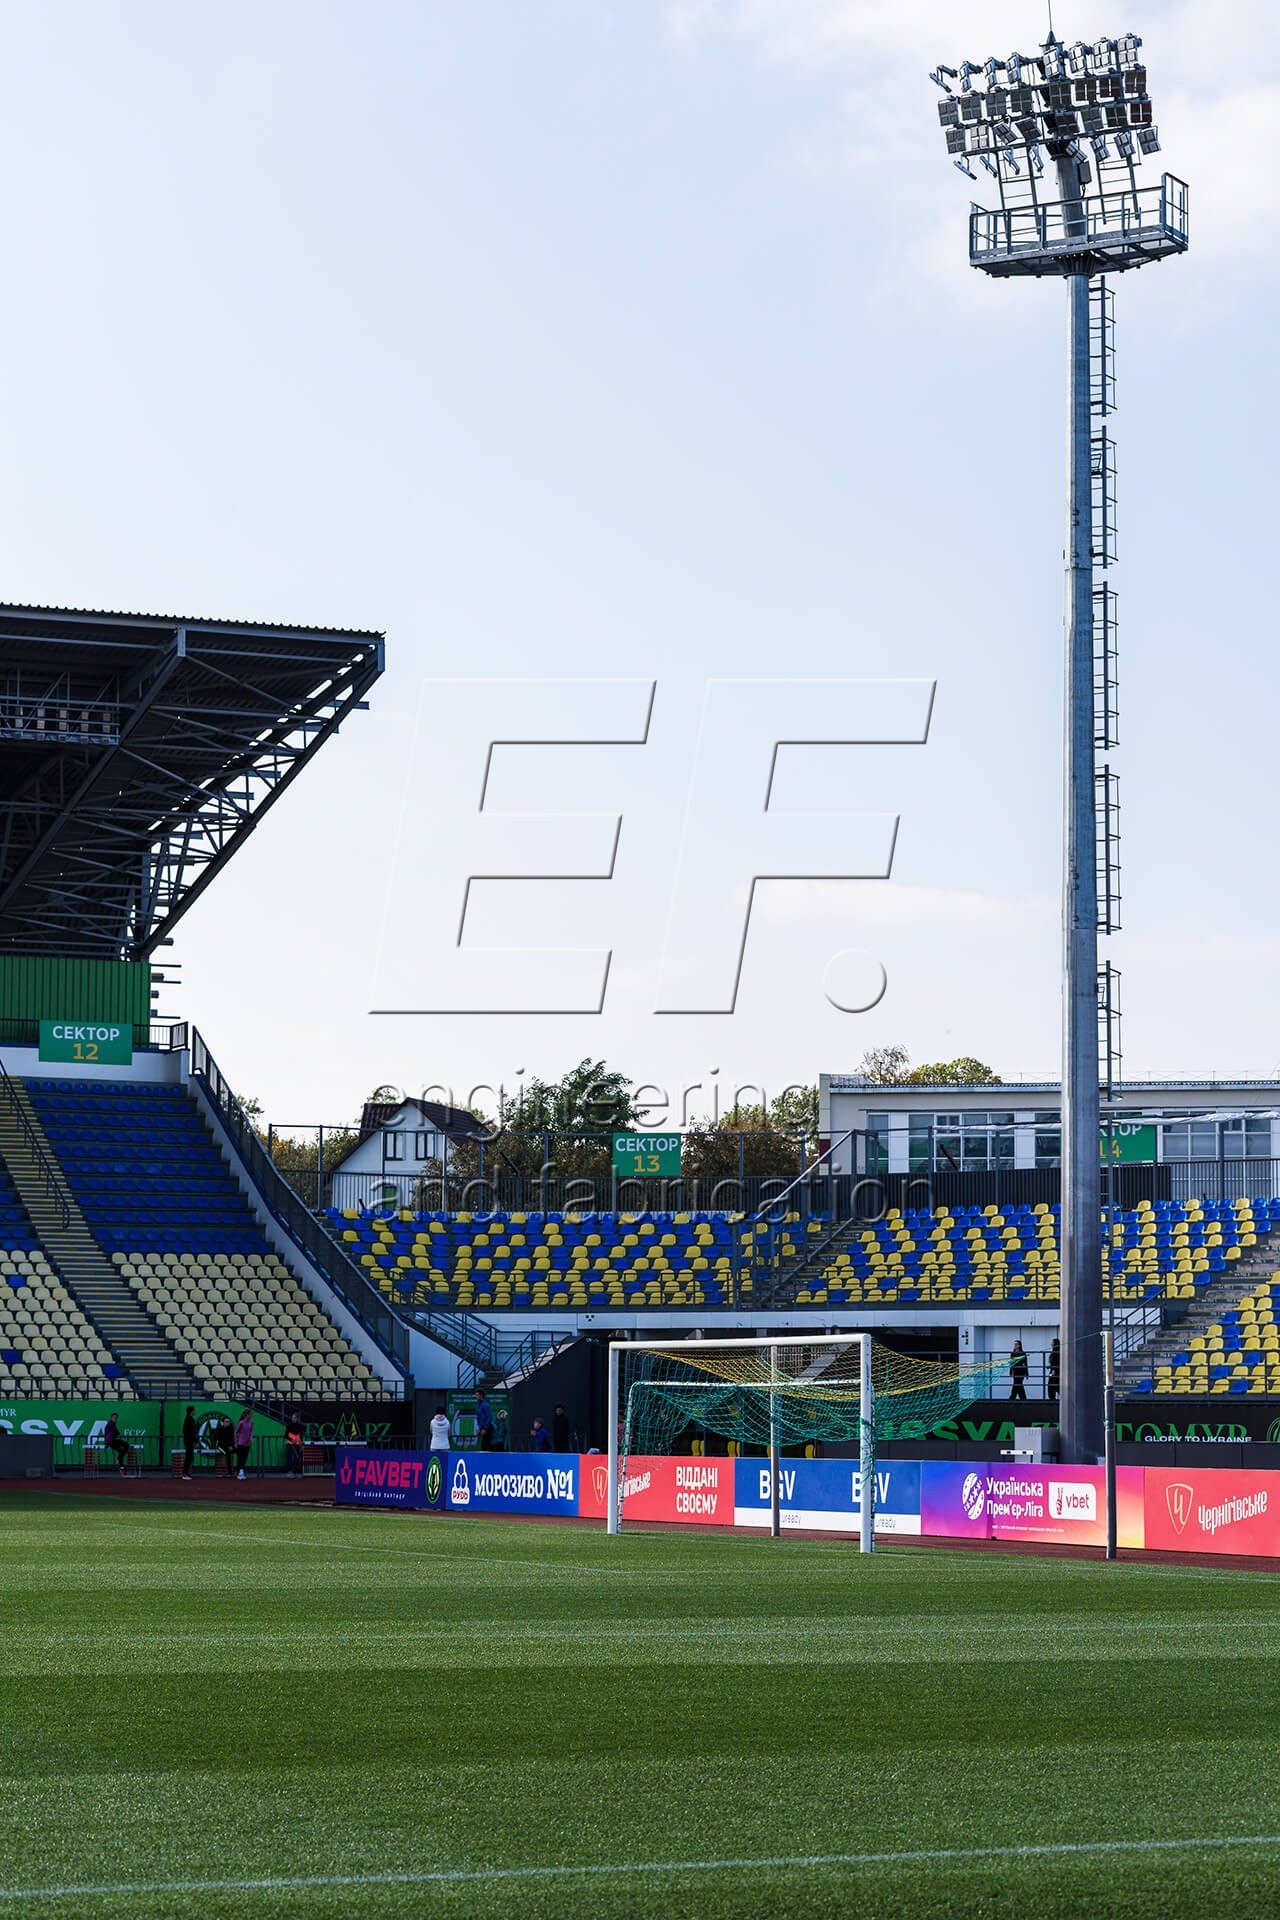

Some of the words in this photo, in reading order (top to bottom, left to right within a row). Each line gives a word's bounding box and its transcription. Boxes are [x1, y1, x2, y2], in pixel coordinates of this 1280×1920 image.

[52, 1025, 120, 1041] СЕКТОР
[73, 1043, 99, 1061] 12
[615, 1137, 679, 1153] СЕКТОР
[633, 1154, 661, 1173] 13
[1144, 1435, 1182, 1443] GLORY
[355, 1459, 424, 1488] FAVBET
[676, 1466, 718, 1489] ВІДДАНІ
[474, 1473, 544, 1499] МОРОЗИВО
[852, 1472, 890, 1504] BV
[986, 1477, 1043, 1499] Українська
[676, 1493, 717, 1515] СВОЄМУ
[1066, 1493, 1090, 1509] vbet
[1198, 1490, 1268, 1536] Чернігівське
